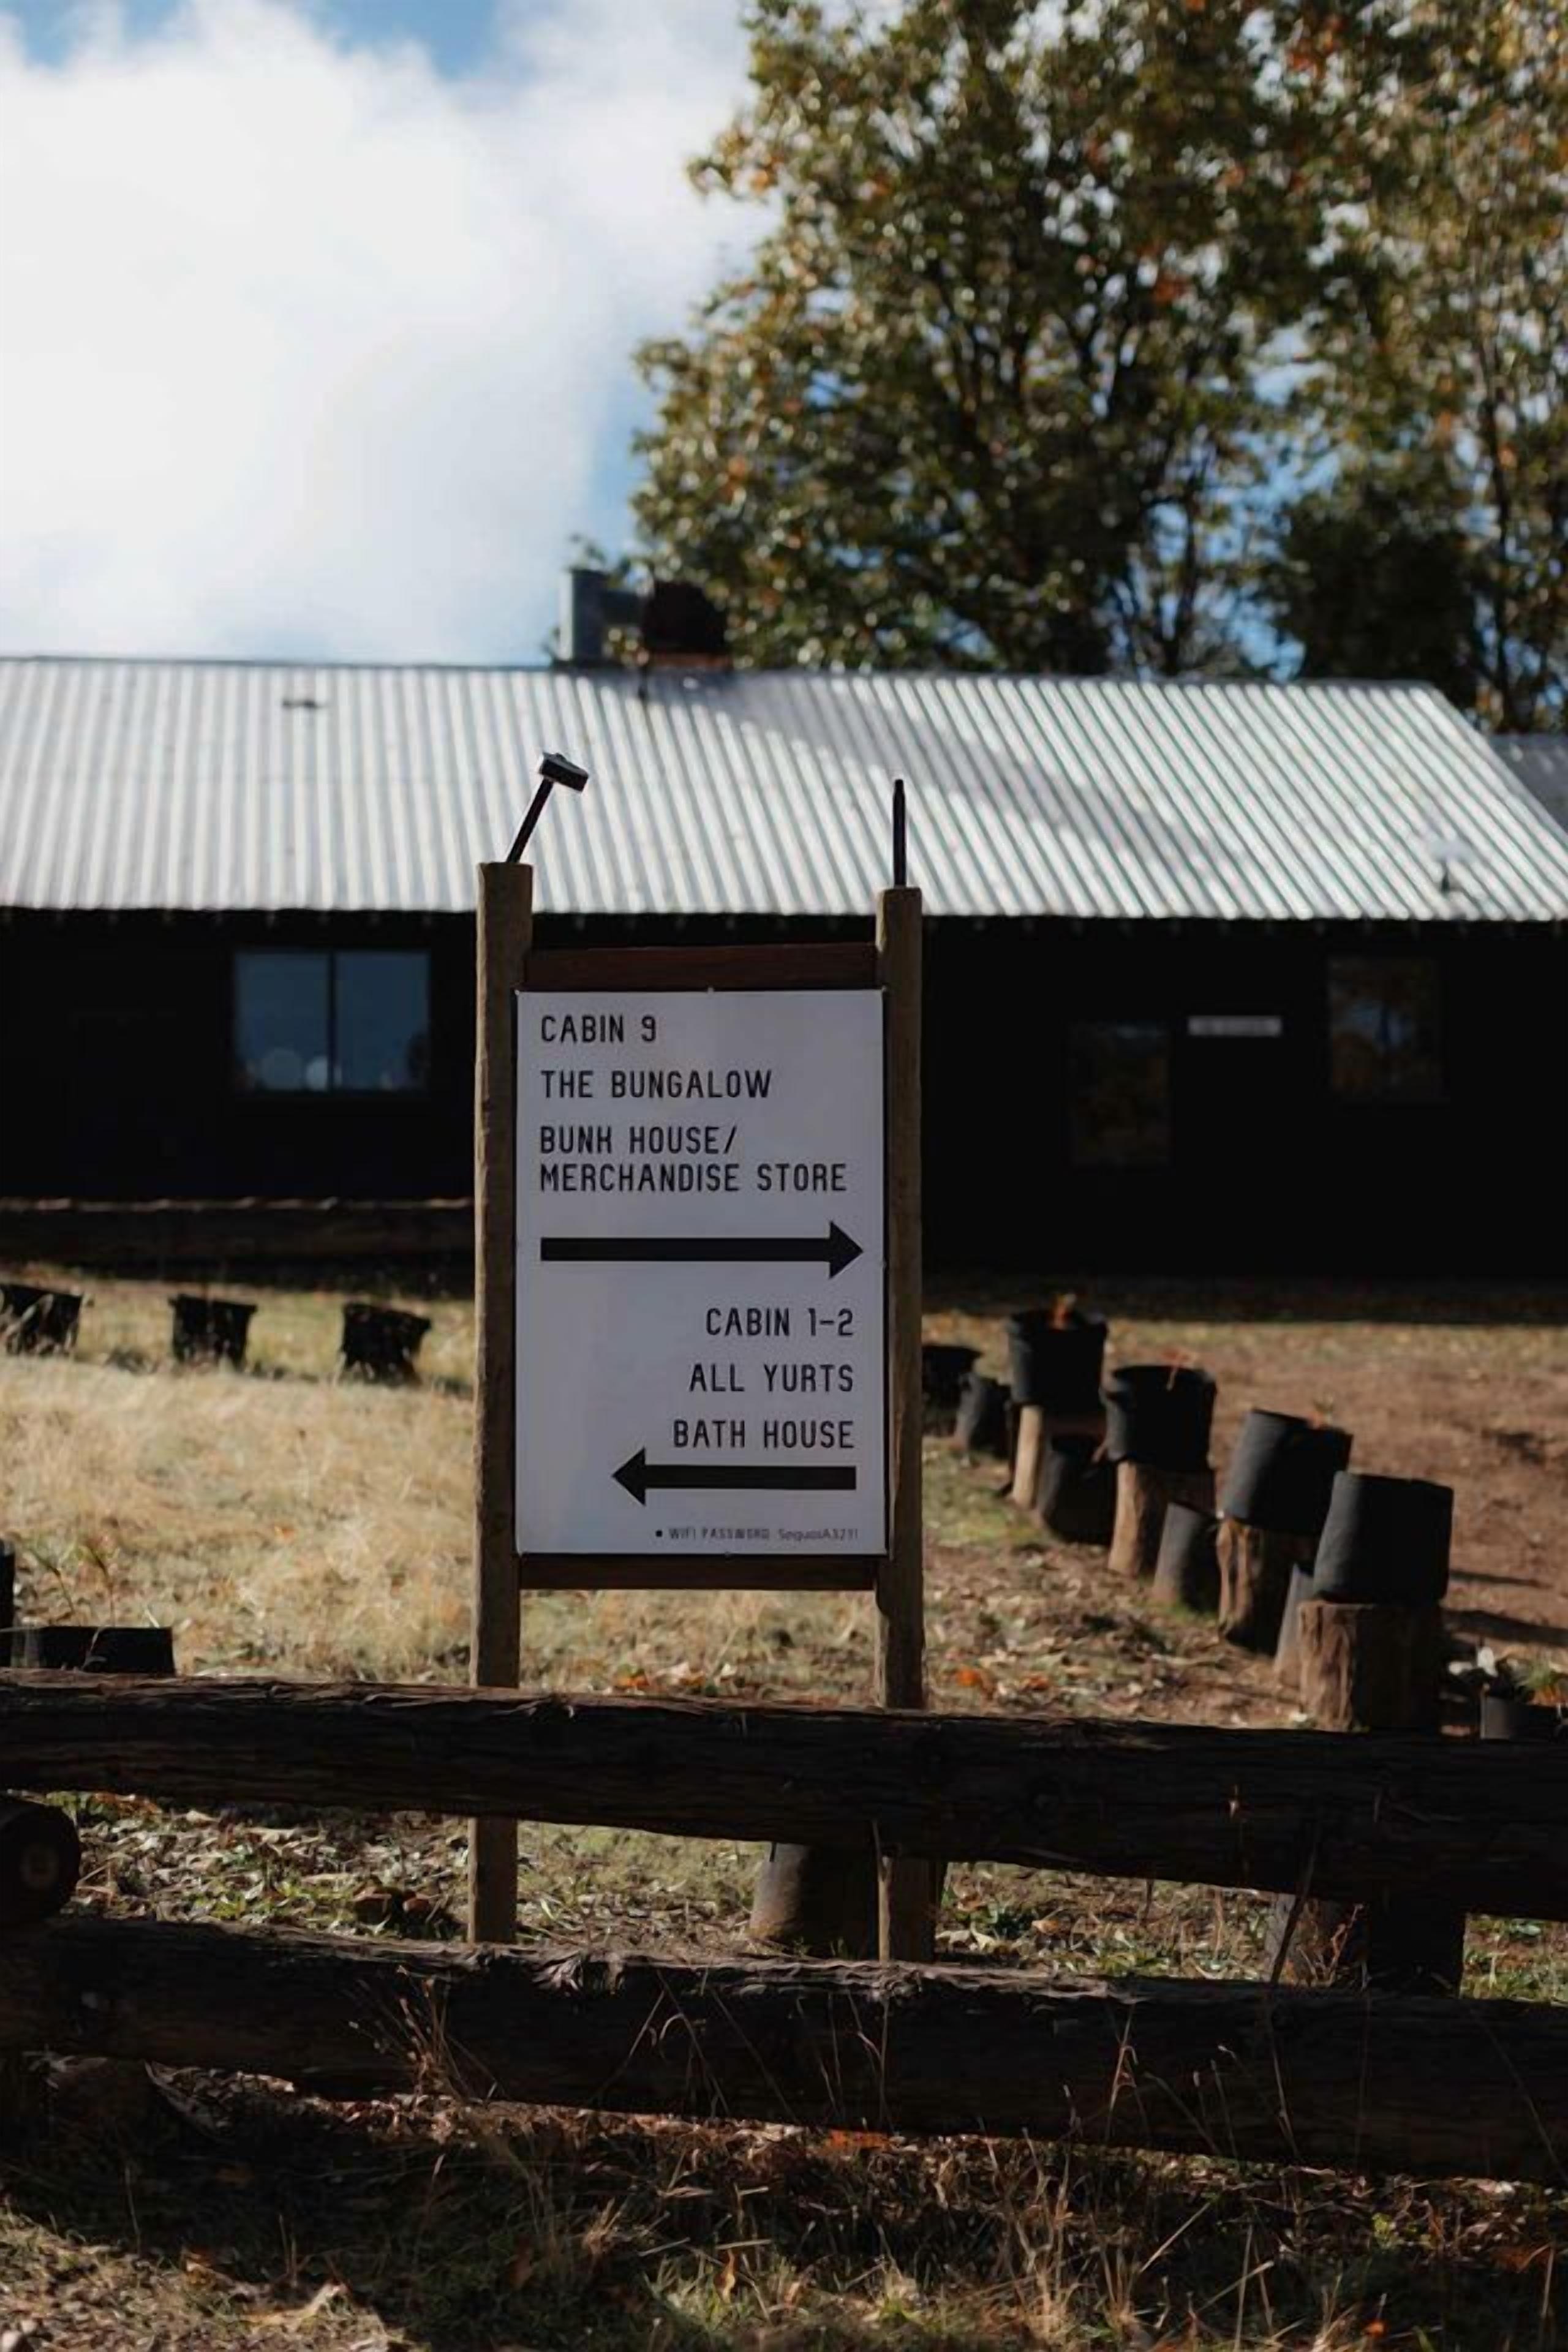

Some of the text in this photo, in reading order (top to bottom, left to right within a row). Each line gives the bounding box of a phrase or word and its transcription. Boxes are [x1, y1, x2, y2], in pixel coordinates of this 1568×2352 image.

[541, 1014, 657, 1044] CABIN 9
[540, 1069, 772, 1099] THE BUNGALOW
[540, 1125, 737, 1155] BUNK HOUSE/
[540, 1163, 847, 1193] MERCHANDISE STORE
[706, 1307, 854, 1336] CABIN 1-2
[688, 1363, 854, 1392] ALL YURTS
[673, 1419, 854, 1449] BATH HOUSE
[701, 1527, 771, 1540] PASSWORD
